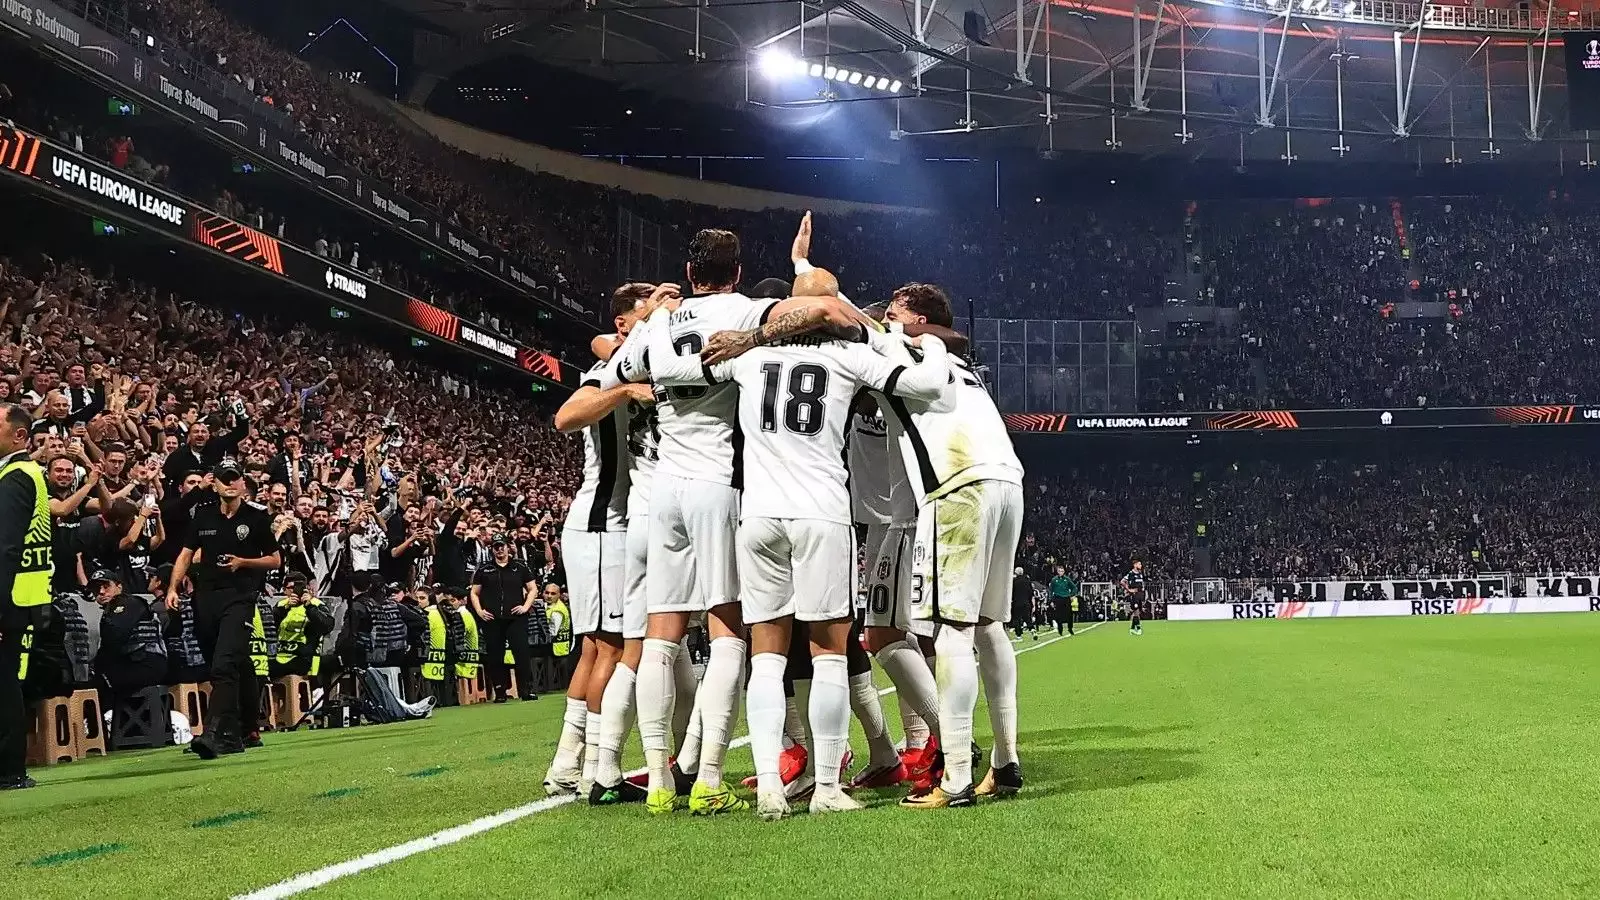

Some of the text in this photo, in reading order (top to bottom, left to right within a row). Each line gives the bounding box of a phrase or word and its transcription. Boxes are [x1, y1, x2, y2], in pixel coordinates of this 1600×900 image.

[35, 8, 80, 47] Stadyumu
[52, 155, 183, 226] UEFA EUROPA LEAGUE
[334, 272, 367, 299] STRAUSS
[461, 325, 517, 359] UEFA EUROPA LEAGUE
[760, 360, 830, 436] 18
[1076, 417, 1189, 428] UEFA EUROPA LEAGUE
[1232, 603, 1276, 620] RISE
[1411, 599, 1455, 616] RISE
